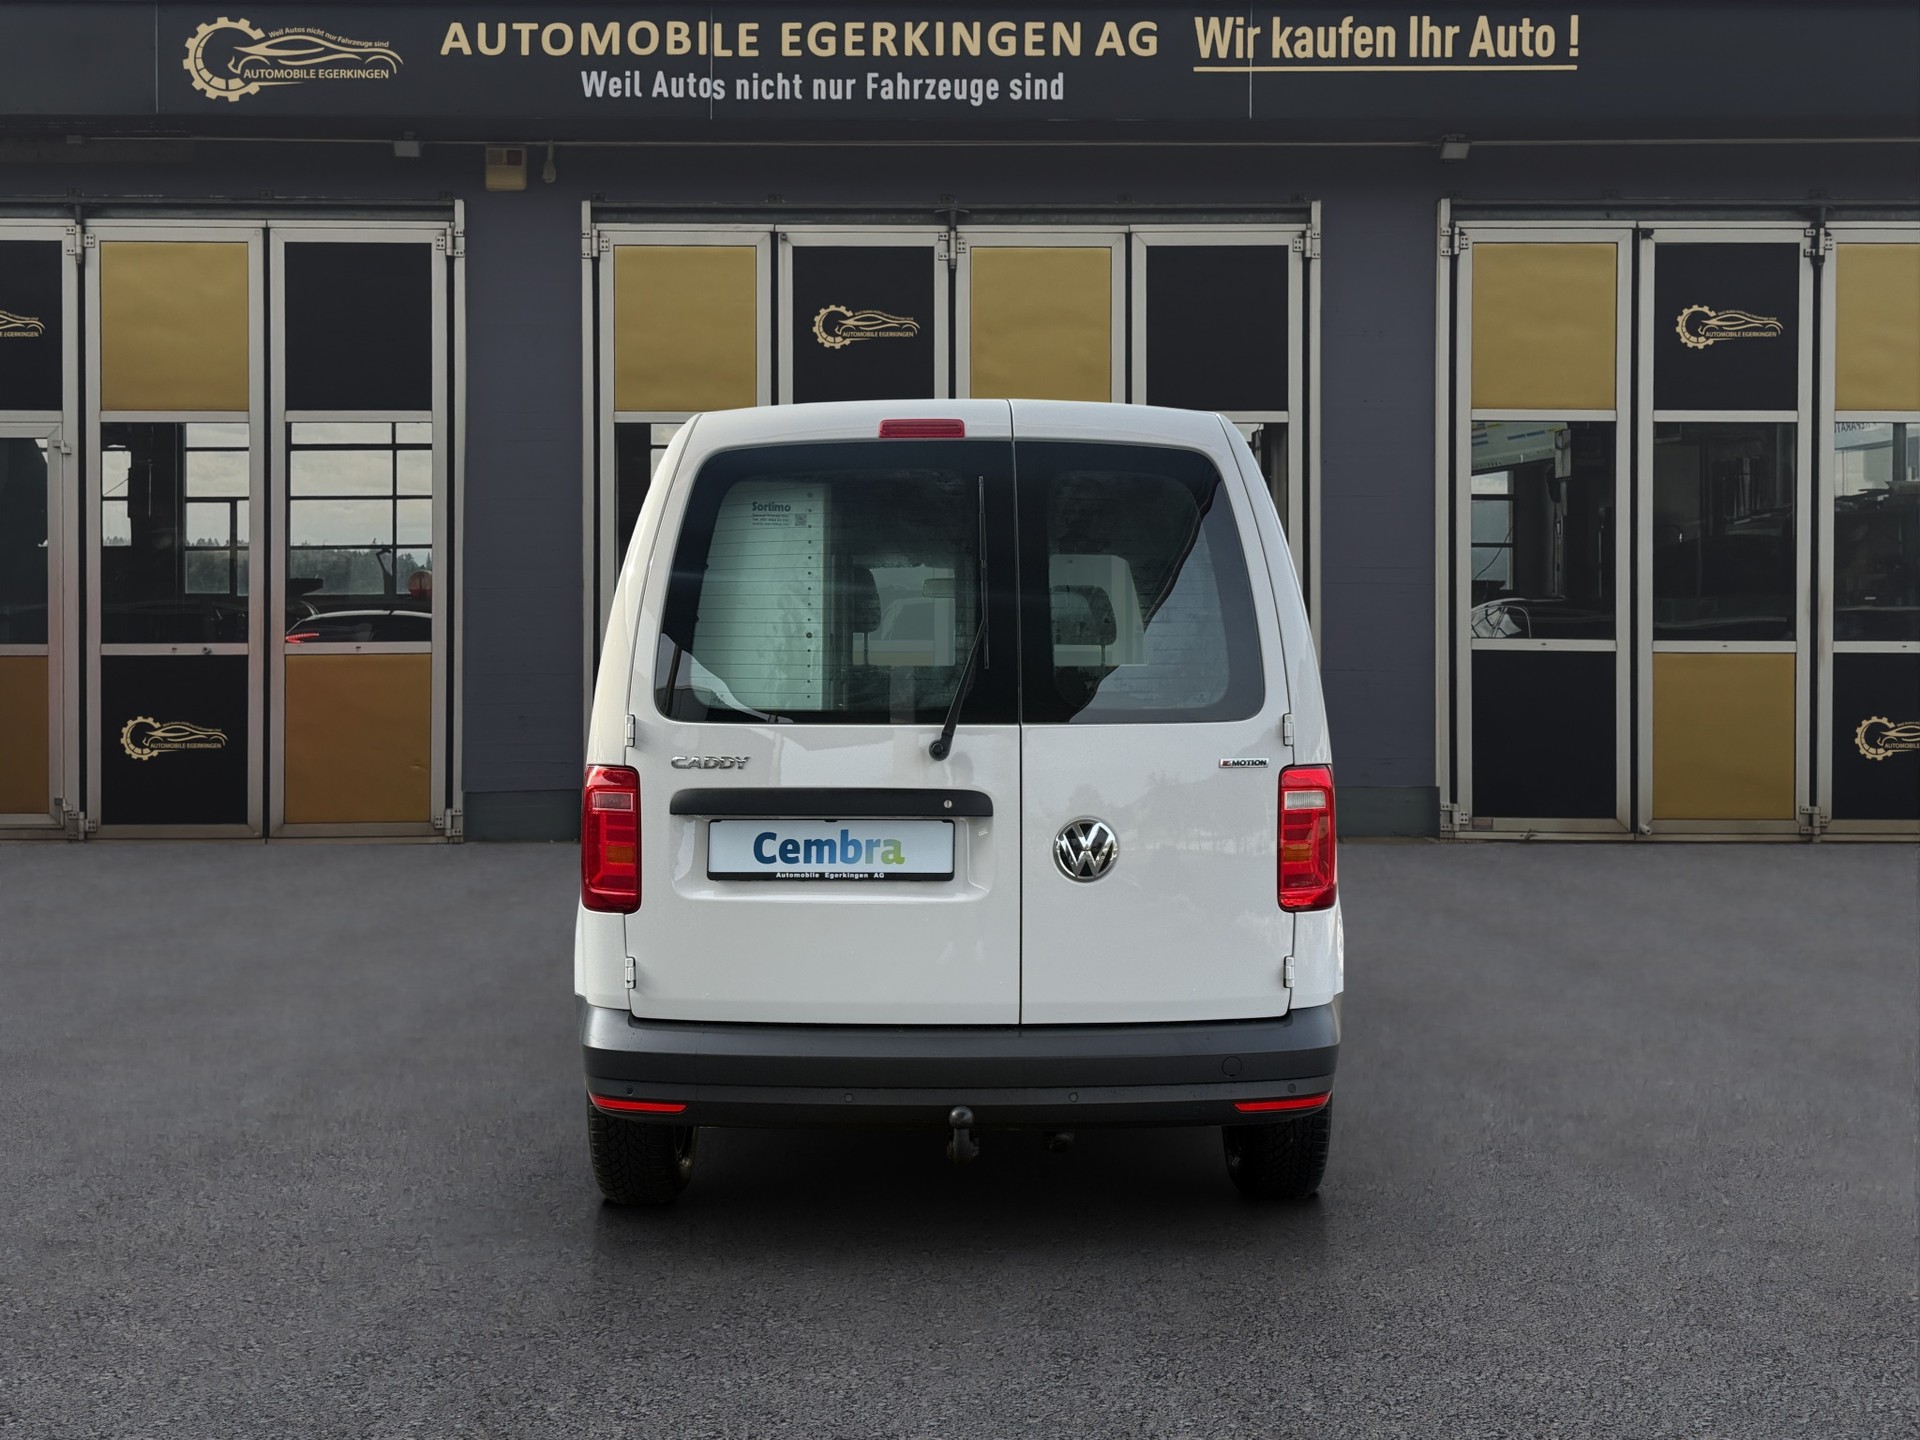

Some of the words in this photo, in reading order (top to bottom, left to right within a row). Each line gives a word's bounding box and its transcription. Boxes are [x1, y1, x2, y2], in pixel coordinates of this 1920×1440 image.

[268, 28, 284, 39] Weil
[285, 26, 306, 35] Autos
[306, 26, 325, 38] nicht
[324, 32, 337, 42] nur
[337, 35, 373, 48] Fahrzeuge
[373, 40, 390, 48] sind
[440, 20, 760, 57] AUTOMOBILE
[781, 21, 1082, 57] EGERKINGEN
[1095, 21, 1158, 57] AG
[1194, 16, 1261, 59] Wir
[1271, 15, 1396, 59] kaufen
[1409, 15, 1460, 58] Ihr
[1468, 15, 1556, 58] Auto
[243, 68, 316, 79] AUTOMOBILE
[318, 68, 389, 79] EGERKINGEN
[581, 70, 642, 98] Weil
[652, 70, 726, 100] Autos
[736, 72, 803, 100] nicht
[813, 76, 856, 100] nur
[866, 72, 1000, 107] Fahrzeuge
[1009, 72, 1064, 100] sind
[751, 501, 791, 512] Sortimo
[671, 756, 750, 770] CADDY
[753, 829, 905, 865] Cembra
